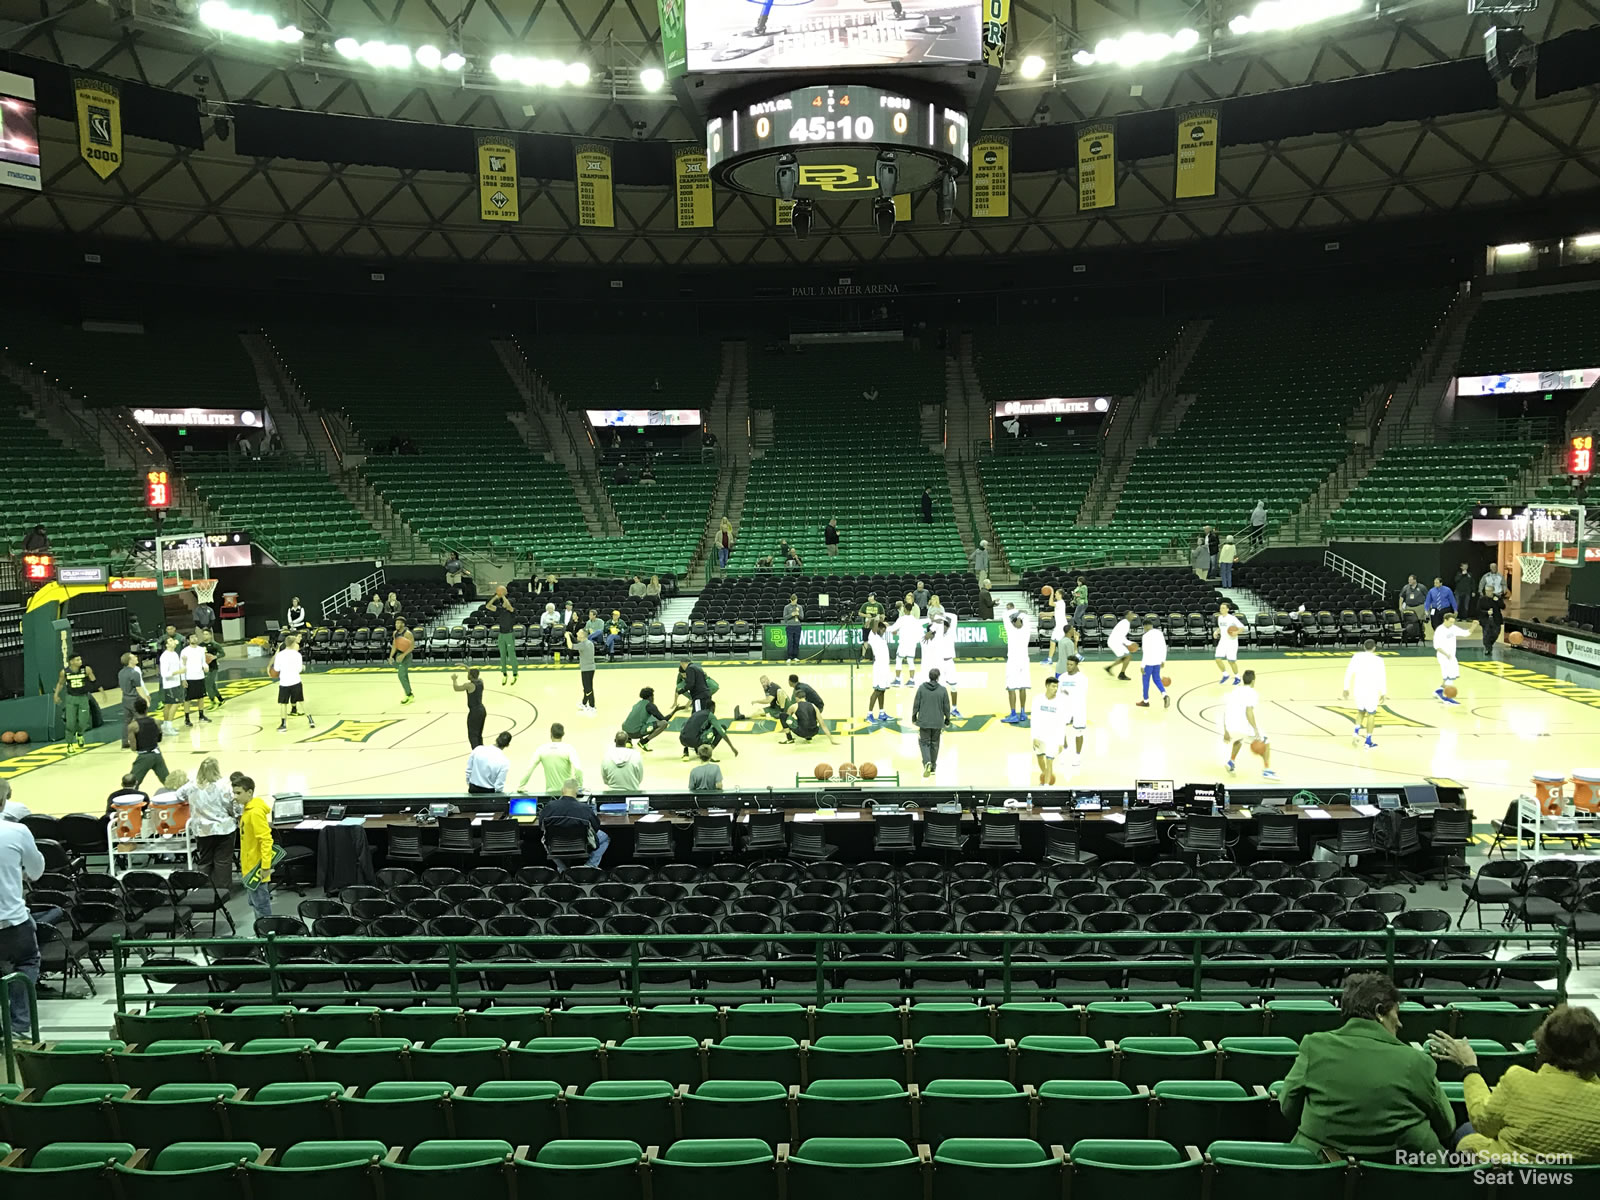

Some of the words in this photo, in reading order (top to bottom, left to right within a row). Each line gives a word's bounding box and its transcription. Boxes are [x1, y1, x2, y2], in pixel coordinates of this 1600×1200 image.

[812, 96, 822, 107] 4
[839, 95, 850, 106] 4
[750, 98, 792, 116] BAYLOR
[756, 117, 769, 138] 0
[789, 115, 874, 142] 45:10
[893, 112, 907, 134] 0
[86, 147, 118, 163] 2000
[8, 170, 36, 181] mazda
[792, 287, 816, 296] PAUL
[827, 286, 863, 296] MEYER
[864, 284, 899, 294] ARENA
[31, 565, 44, 577] 30
[122, 580, 141, 588] State
[141, 580, 157, 588] Farm
[799, 629, 848, 645] WELCOME
[852, 629, 864, 644] TO
[1522, 628, 1538, 638] Waco
[1574, 644, 1592, 654] BAYLOR
[70, 679, 83, 688] 25
[1549, 788, 1560, 798] G
[119, 811, 128, 820] G
[158, 810, 168, 820] G
